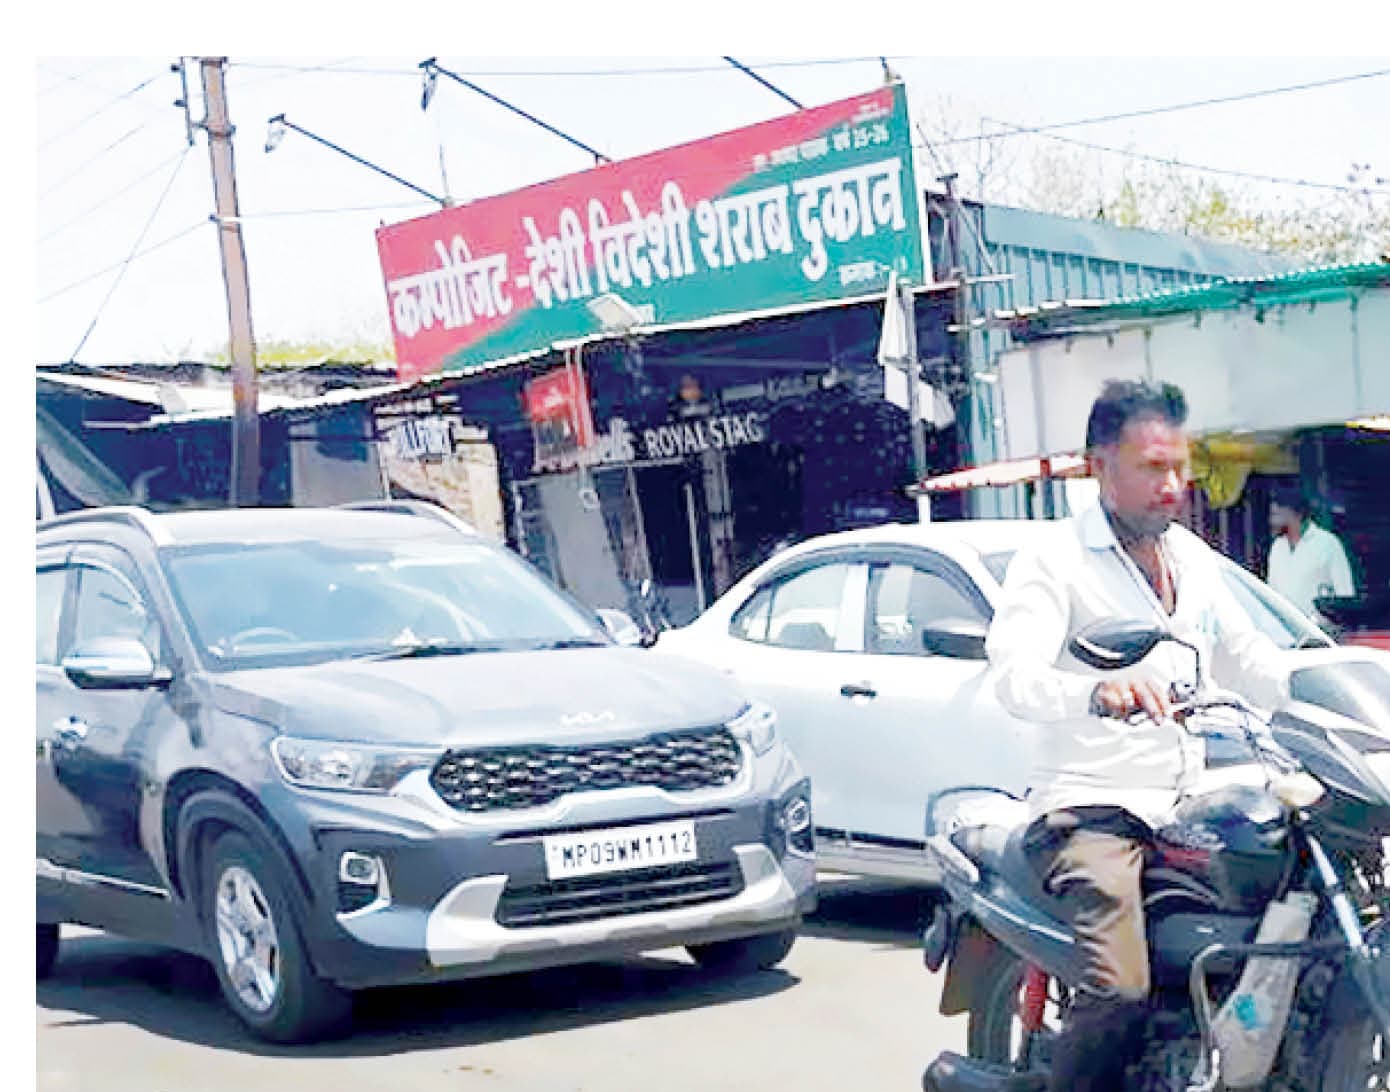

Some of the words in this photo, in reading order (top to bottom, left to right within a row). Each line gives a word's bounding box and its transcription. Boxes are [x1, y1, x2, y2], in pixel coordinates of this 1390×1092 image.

[588, 180, 697, 293] विदेशी
[695, 184, 794, 269] शराब
[793, 156, 906, 282] दुकान
[644, 421, 704, 460] ROYAL
[708, 410, 768, 451] STAG
